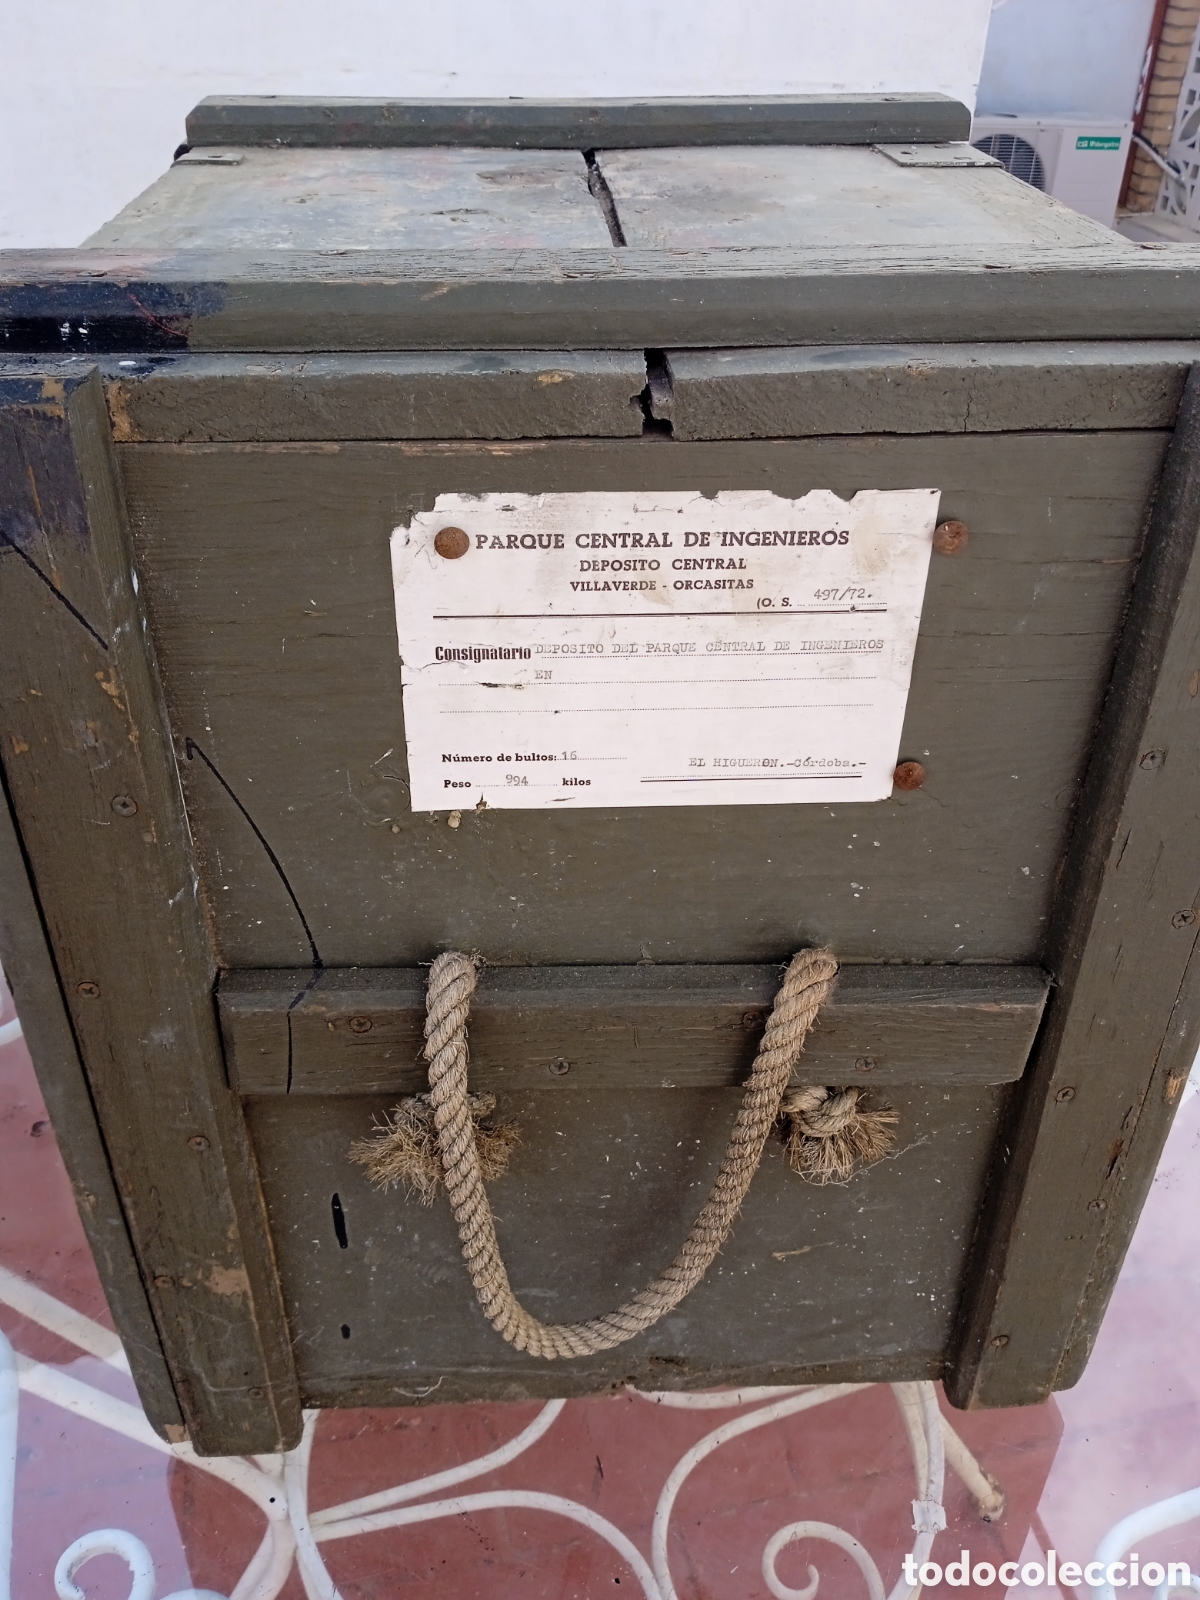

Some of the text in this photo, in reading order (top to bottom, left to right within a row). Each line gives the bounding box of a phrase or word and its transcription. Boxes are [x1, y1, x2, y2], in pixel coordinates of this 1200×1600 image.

[476, 530, 849, 549] PARQUE CENTRAL DE INGENIEROS
[580, 558, 747, 572] DEPOSITO CENTRAL
[570, 580, 656, 591] VILLAVERDE
[673, 579, 754, 590] ORCASITAS
[781, 597, 792, 607] S.
[814, 586, 873, 601] 497/72.
[435, 639, 884, 663] Consignatario DEPOSITO DEL PARQUE CENTRAL DE INGENIEROS
[534, 670, 553, 680] EN
[442, 751, 577, 763] Número de bultos: 16
[688, 758, 706, 767] EL
[444, 774, 591, 788] Peso 994 kilos
